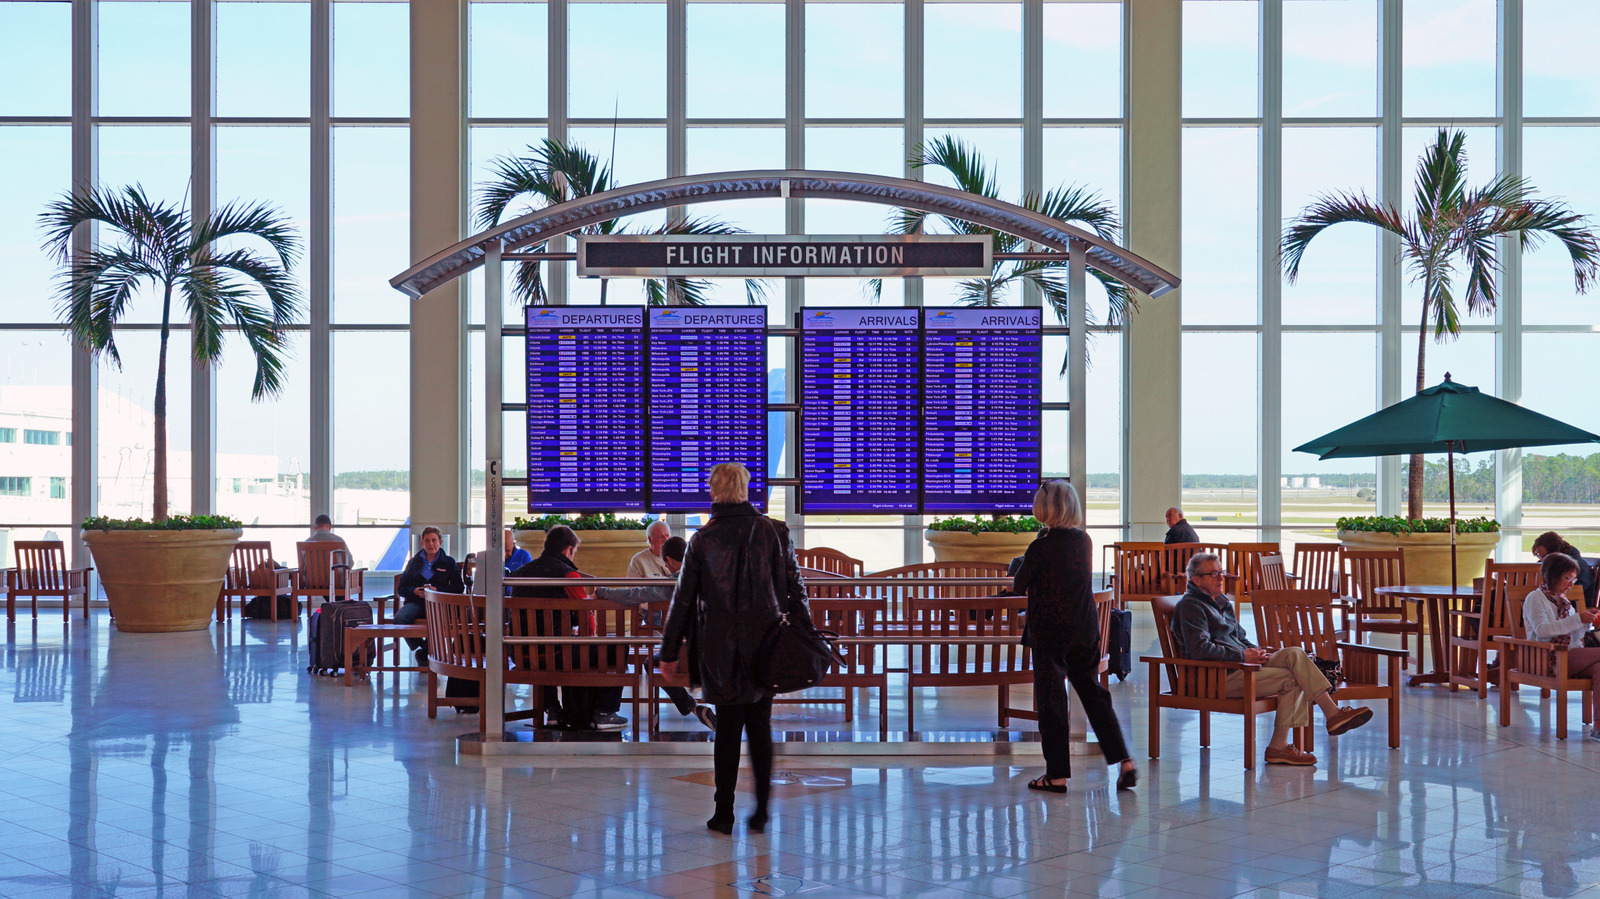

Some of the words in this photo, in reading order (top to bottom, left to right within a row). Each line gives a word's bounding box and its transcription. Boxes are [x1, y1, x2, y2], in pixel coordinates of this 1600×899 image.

[666, 246, 742, 264] FLIGHT
[753, 246, 904, 264] INFORMATION
[562, 315, 642, 324] DEPARTURES
[684, 315, 764, 325] DEPARTURES
[859, 316, 917, 326] ARRIVALS
[981, 316, 1039, 326] ARRIVALS
